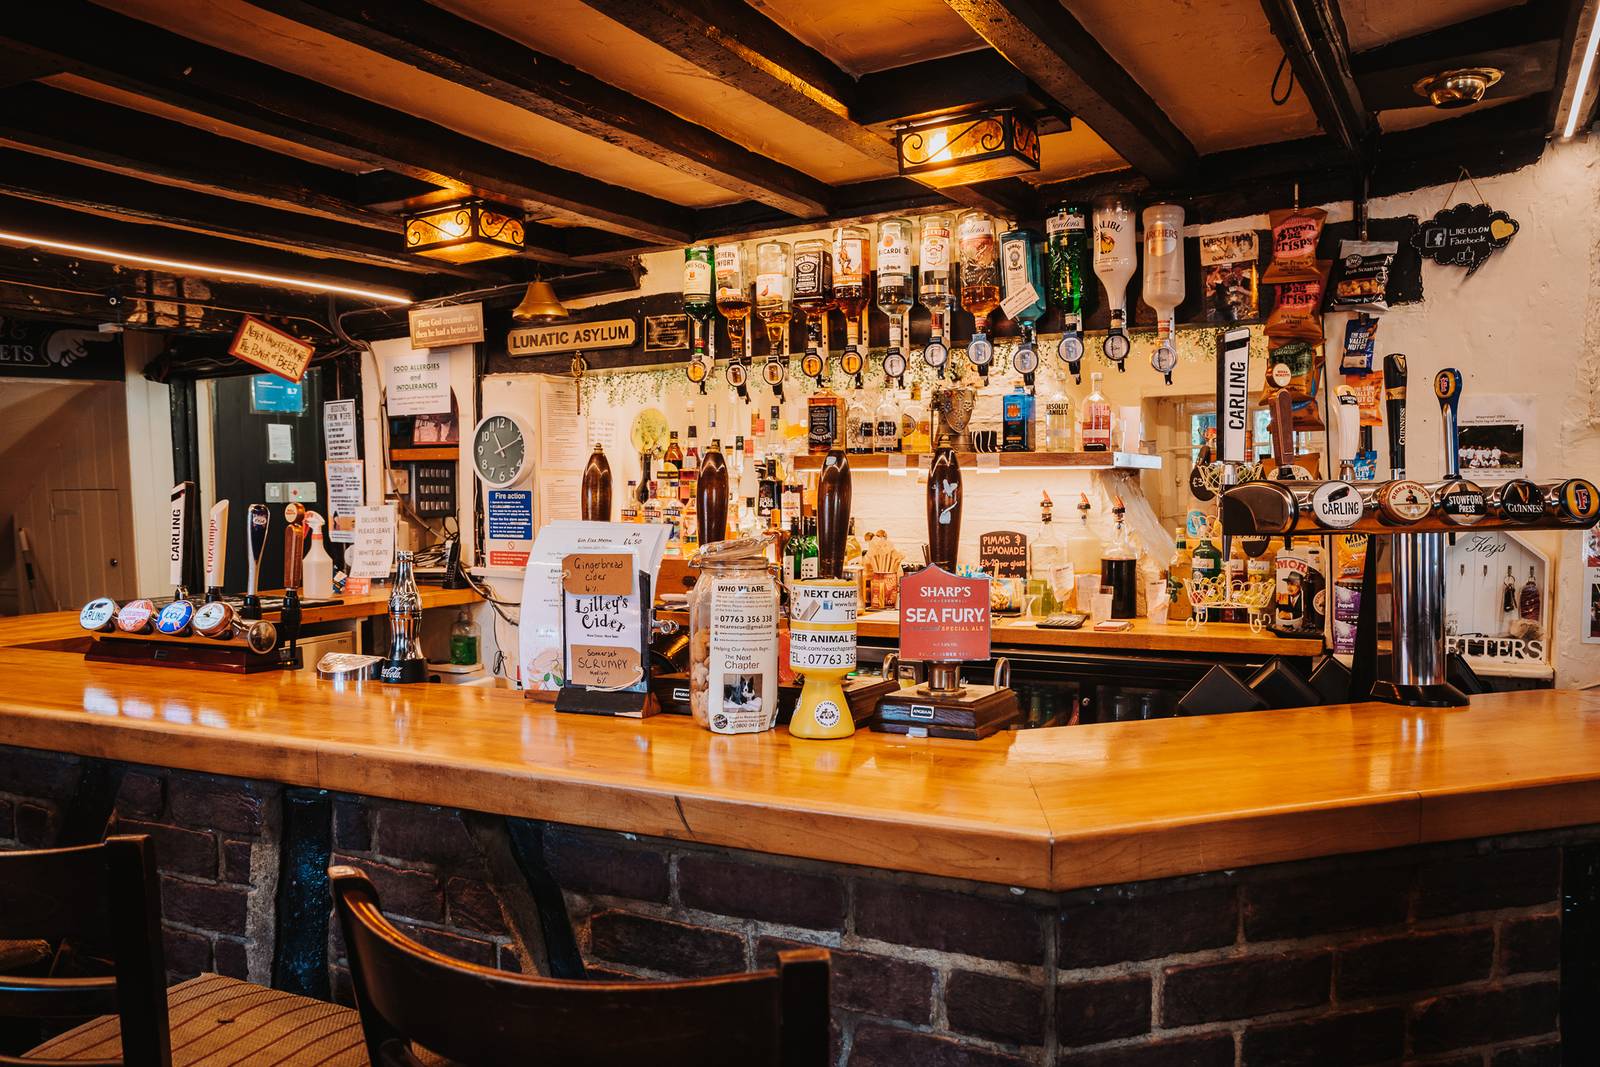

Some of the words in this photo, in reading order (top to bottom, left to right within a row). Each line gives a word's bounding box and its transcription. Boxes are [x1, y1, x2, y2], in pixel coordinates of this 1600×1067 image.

[1093, 219, 1123, 233] MALIBU
[1146, 229, 1179, 241] ARCHERS
[1450, 236, 1486, 246] Facebook
[430, 317, 442, 326] God
[435, 328, 446, 337] had
[450, 327, 467, 336] better
[466, 324, 479, 333] idea
[512, 331, 569, 349] LUNATIC
[573, 325, 630, 343] ASYLUM
[394, 364, 409, 372] FOOD
[410, 362, 440, 371] ALLERGIES
[396, 382, 438, 391] INTOLERANCES
[1228, 361, 1246, 430] CARLING
[496, 418, 506, 429] 12
[481, 431, 490, 442] 10
[477, 445, 484, 455] 9
[481, 459, 488, 470] 8
[489, 467, 495, 478] 7
[499, 471, 506, 482] 6
[509, 467, 515, 477] 5
[495, 492, 507, 500] Fire
[1448, 495, 1484, 505] STOWFORD
[1576, 489, 1588, 510] F
[1322, 502, 1359, 515] CARLING
[1458, 505, 1475, 513] PRESS
[1506, 503, 1543, 513] GUINNESS
[171, 509, 181, 561] CARLING
[982, 536, 1010, 545] PIMMS
[206, 519, 218, 573] Cruzcampo
[982, 546, 1026, 555] LEMONADE
[1466, 536, 1508, 558] Keys
[574, 557, 624, 573] Gingerbread
[1010, 560, 1026, 570] glass
[717, 585, 736, 593] WHO
[803, 590, 830, 598] NEXT
[920, 586, 972, 598] SHARP'S
[575, 595, 629, 615] Lilley's
[720, 615, 745, 623] 07763
[747, 615, 761, 623] 356
[905, 607, 939, 623] SEA
[582, 613, 626, 633] Cider
[810, 634, 849, 643] ANIMAL
[587, 648, 617, 657] Somerset
[1446, 637, 1544, 662] ETTERS
[578, 657, 628, 669] SCRUMPY
[808, 653, 842, 664] 07763
[724, 661, 760, 671] Chapter
